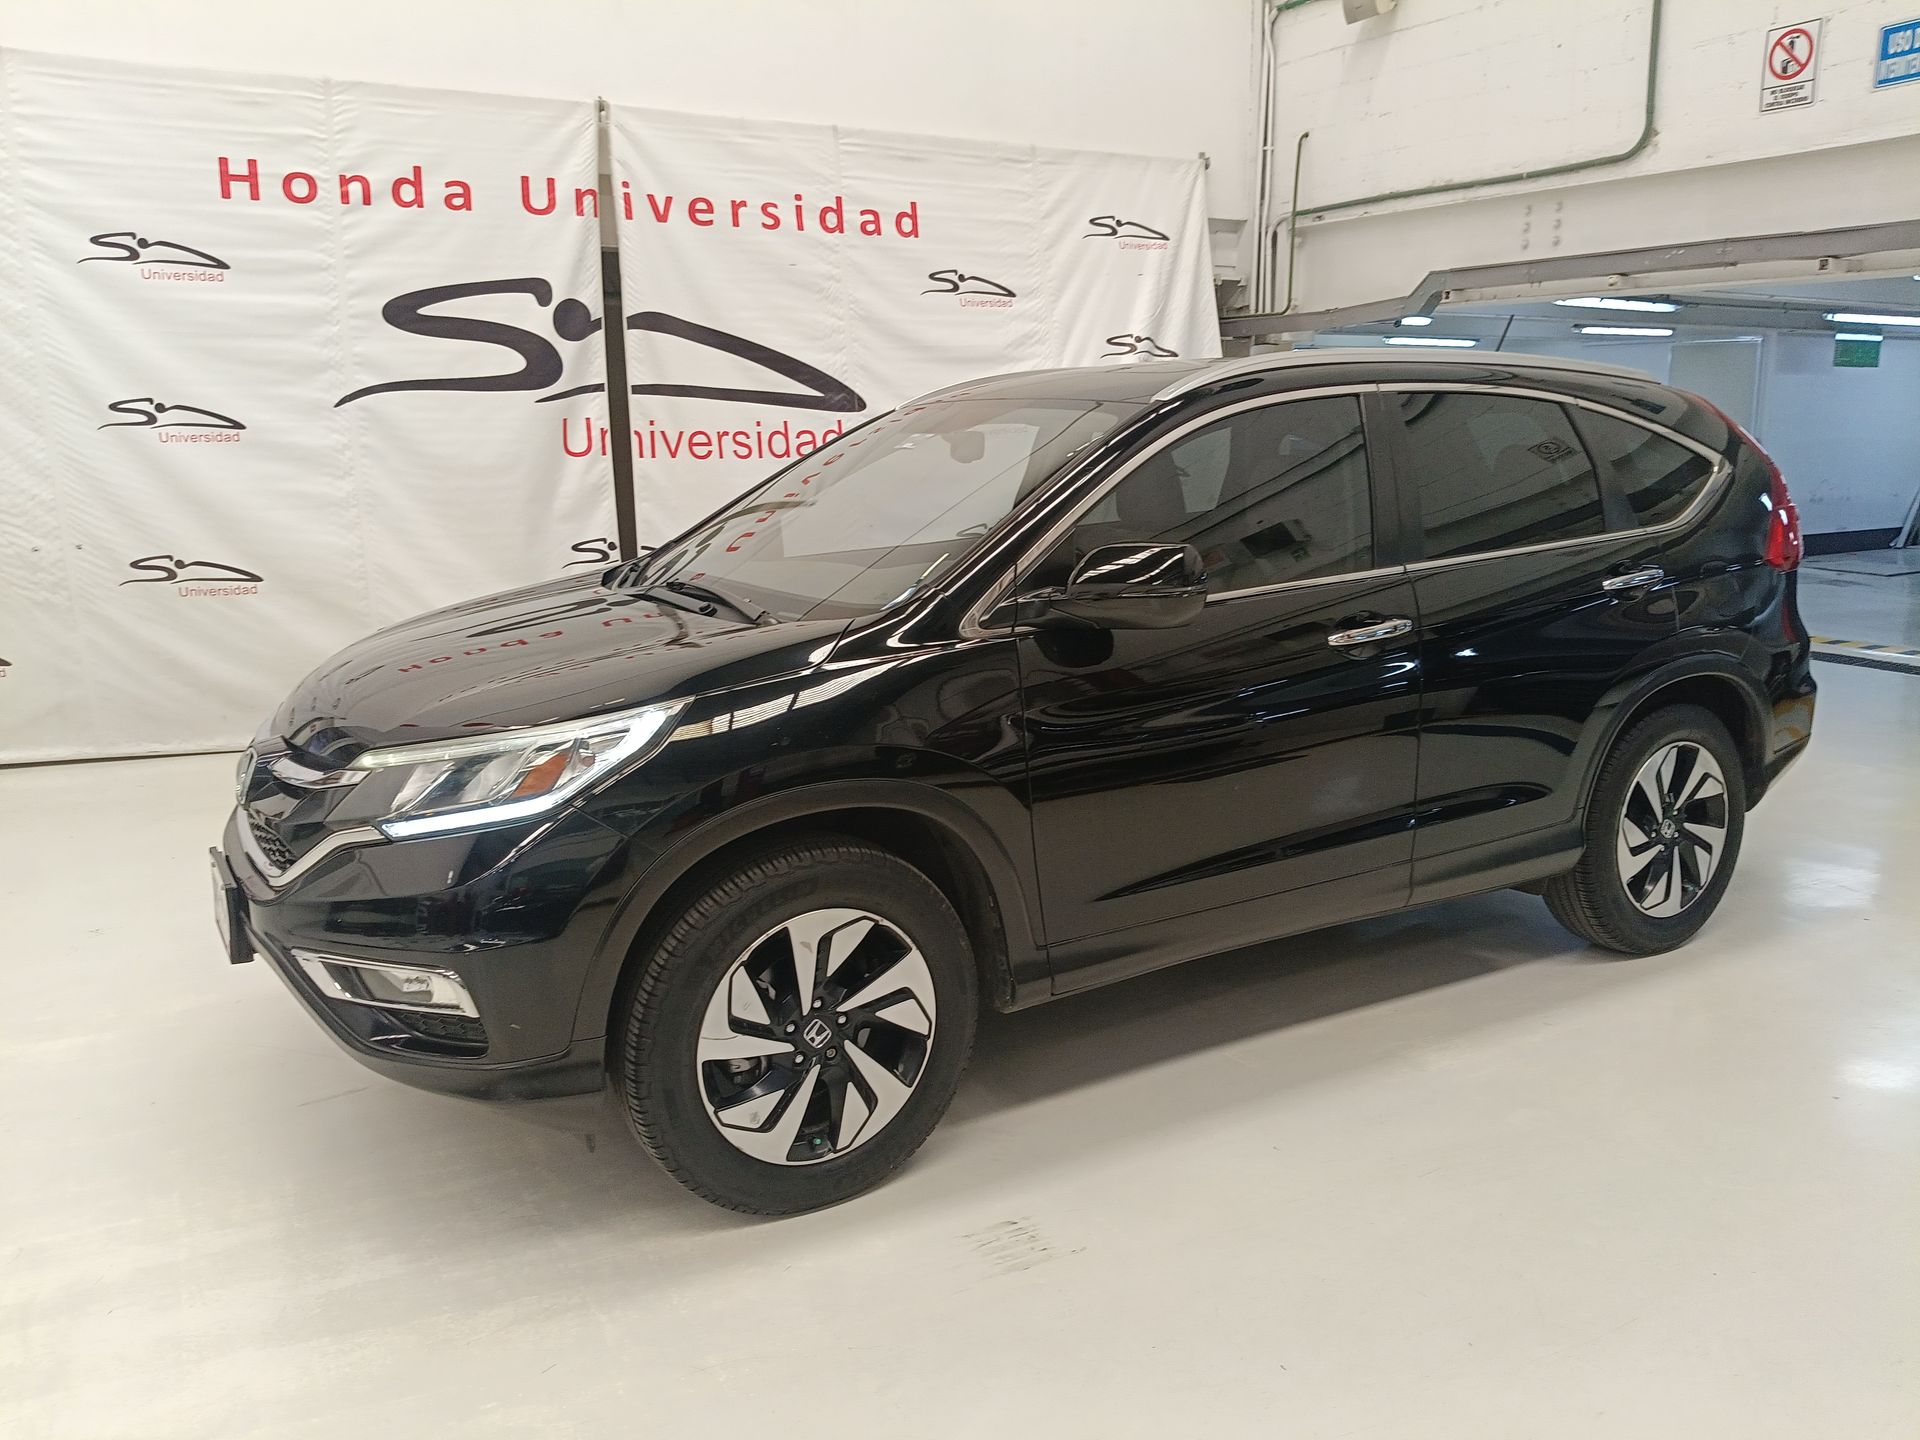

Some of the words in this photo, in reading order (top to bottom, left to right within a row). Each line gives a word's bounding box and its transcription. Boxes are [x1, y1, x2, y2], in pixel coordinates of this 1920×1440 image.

[218, 157, 472, 212] Honda
[520, 175, 919, 239] Universidad
[141, 268, 224, 282] Universidad
[159, 432, 240, 443] Universidad
[178, 584, 258, 597] Universidad
